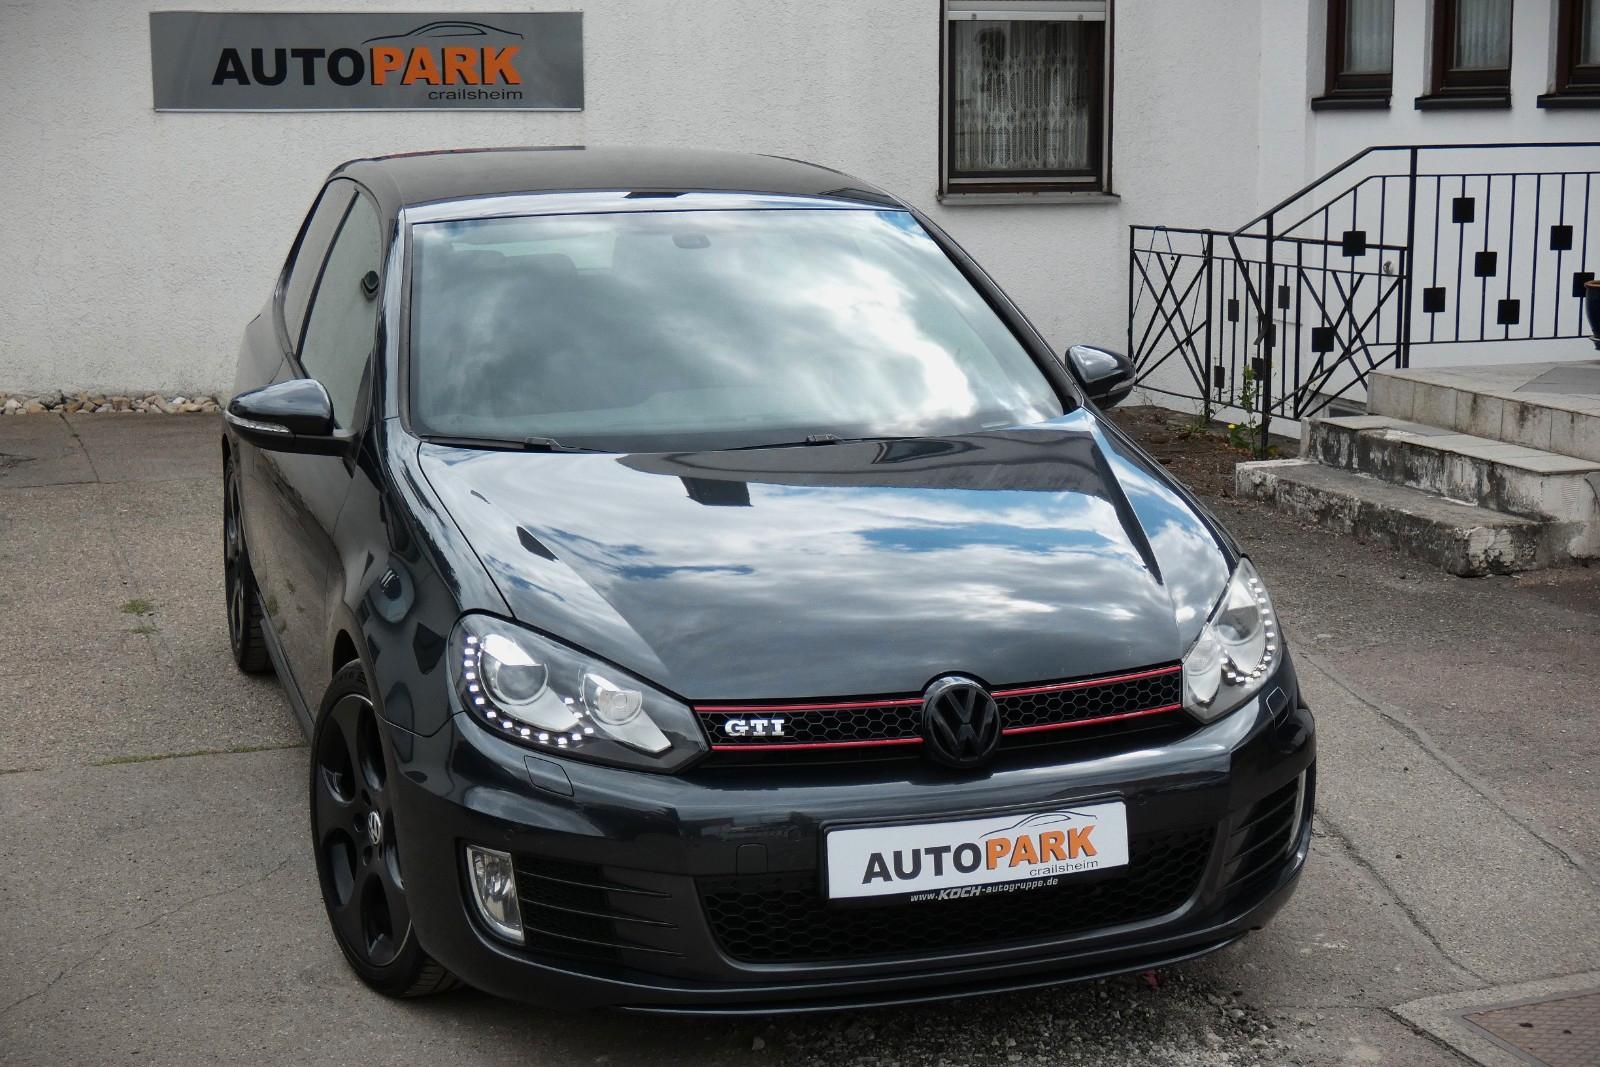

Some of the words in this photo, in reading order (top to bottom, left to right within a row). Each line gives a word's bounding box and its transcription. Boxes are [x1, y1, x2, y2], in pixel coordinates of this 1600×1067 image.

[212, 47, 522, 86] AUTOPARK
[428, 88, 523, 101] crailsheim
[724, 719, 785, 737] GTI
[861, 825, 1097, 884] AUTOPARK
[1029, 859, 1099, 876] crailsheim
[910, 877, 1059, 902] www.KOCH-autogruppe.de
